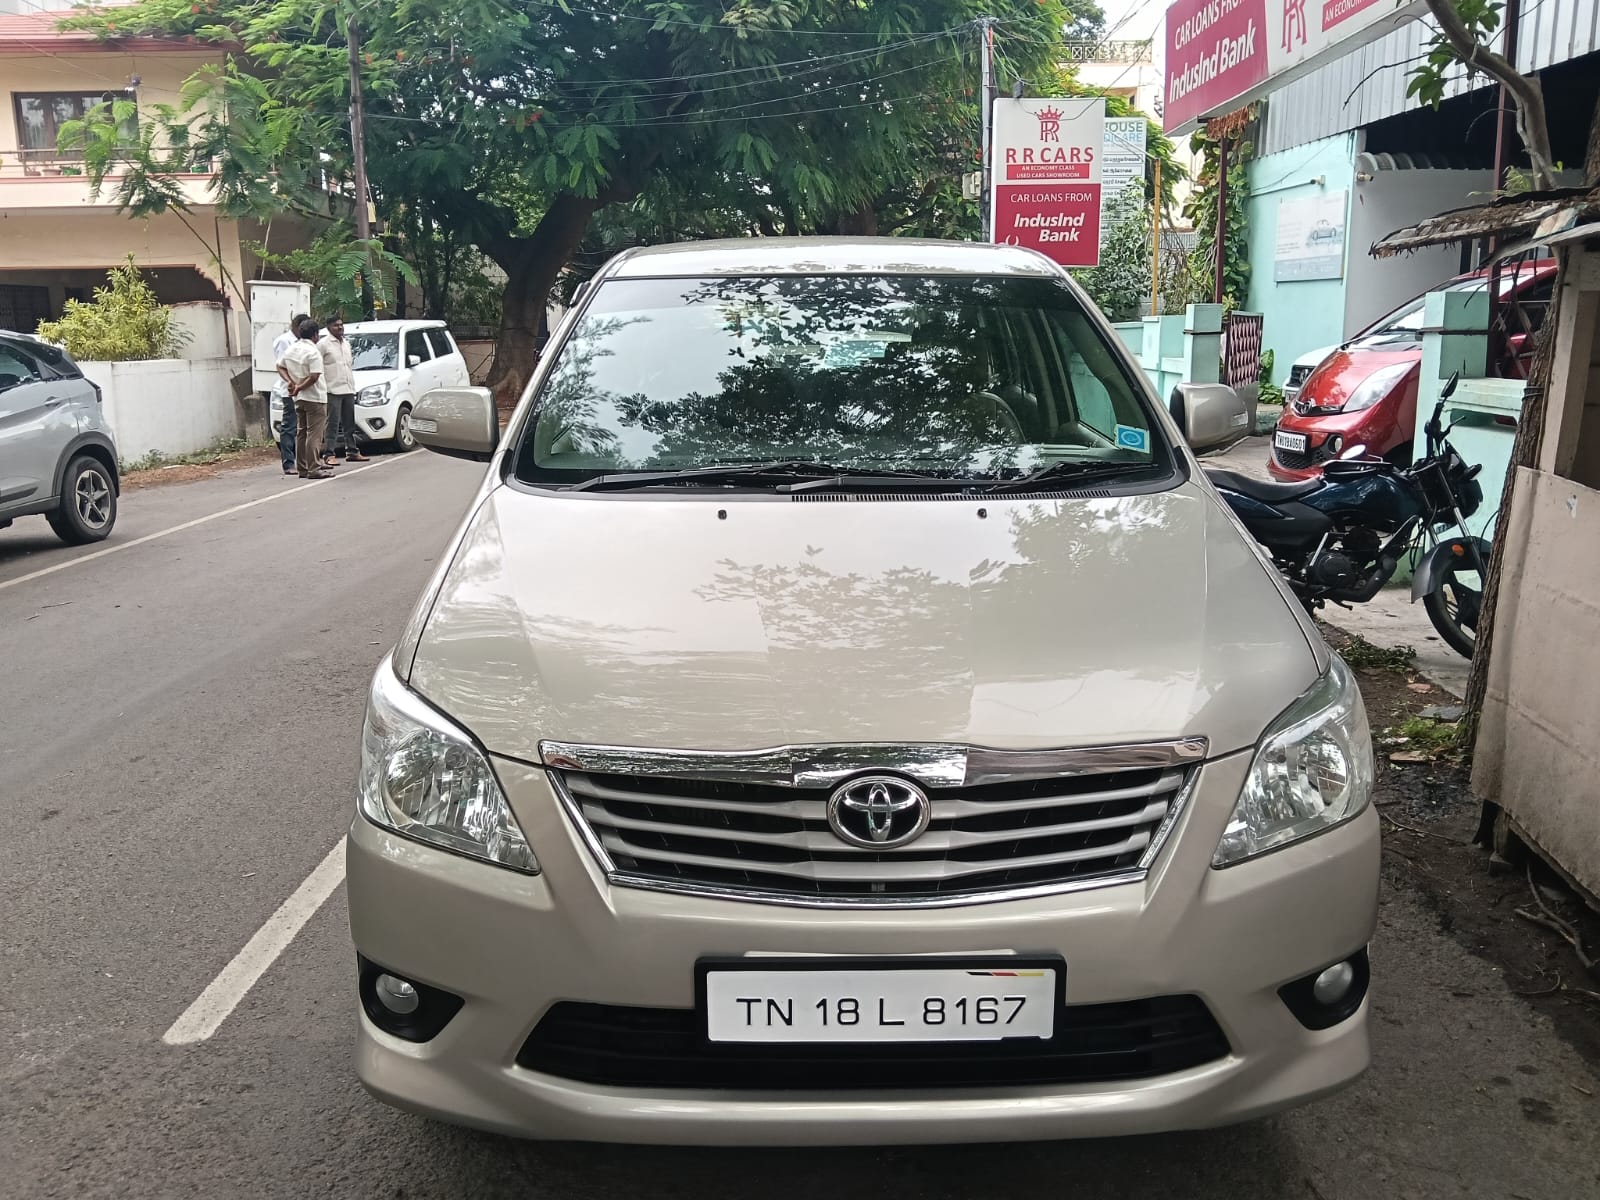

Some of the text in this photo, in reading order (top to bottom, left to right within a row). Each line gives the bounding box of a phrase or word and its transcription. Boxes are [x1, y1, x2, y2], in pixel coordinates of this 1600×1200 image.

[1325, 6, 1334, 24] AN
[1175, 20, 1190, 50] CAR
[1191, 0, 1220, 39] LOANS
[1169, 18, 1256, 104] IndusInd Bank
[1040, 147, 1094, 163] CARS
[1010, 194, 1030, 203] CAR
[1031, 193, 1063, 202] LOANS
[1065, 193, 1092, 202] FROM
[1014, 212, 1085, 228] IndusInd
[1039, 228, 1080, 242] Bank
[736, 996, 1027, 1026] TN 18 L 8167
